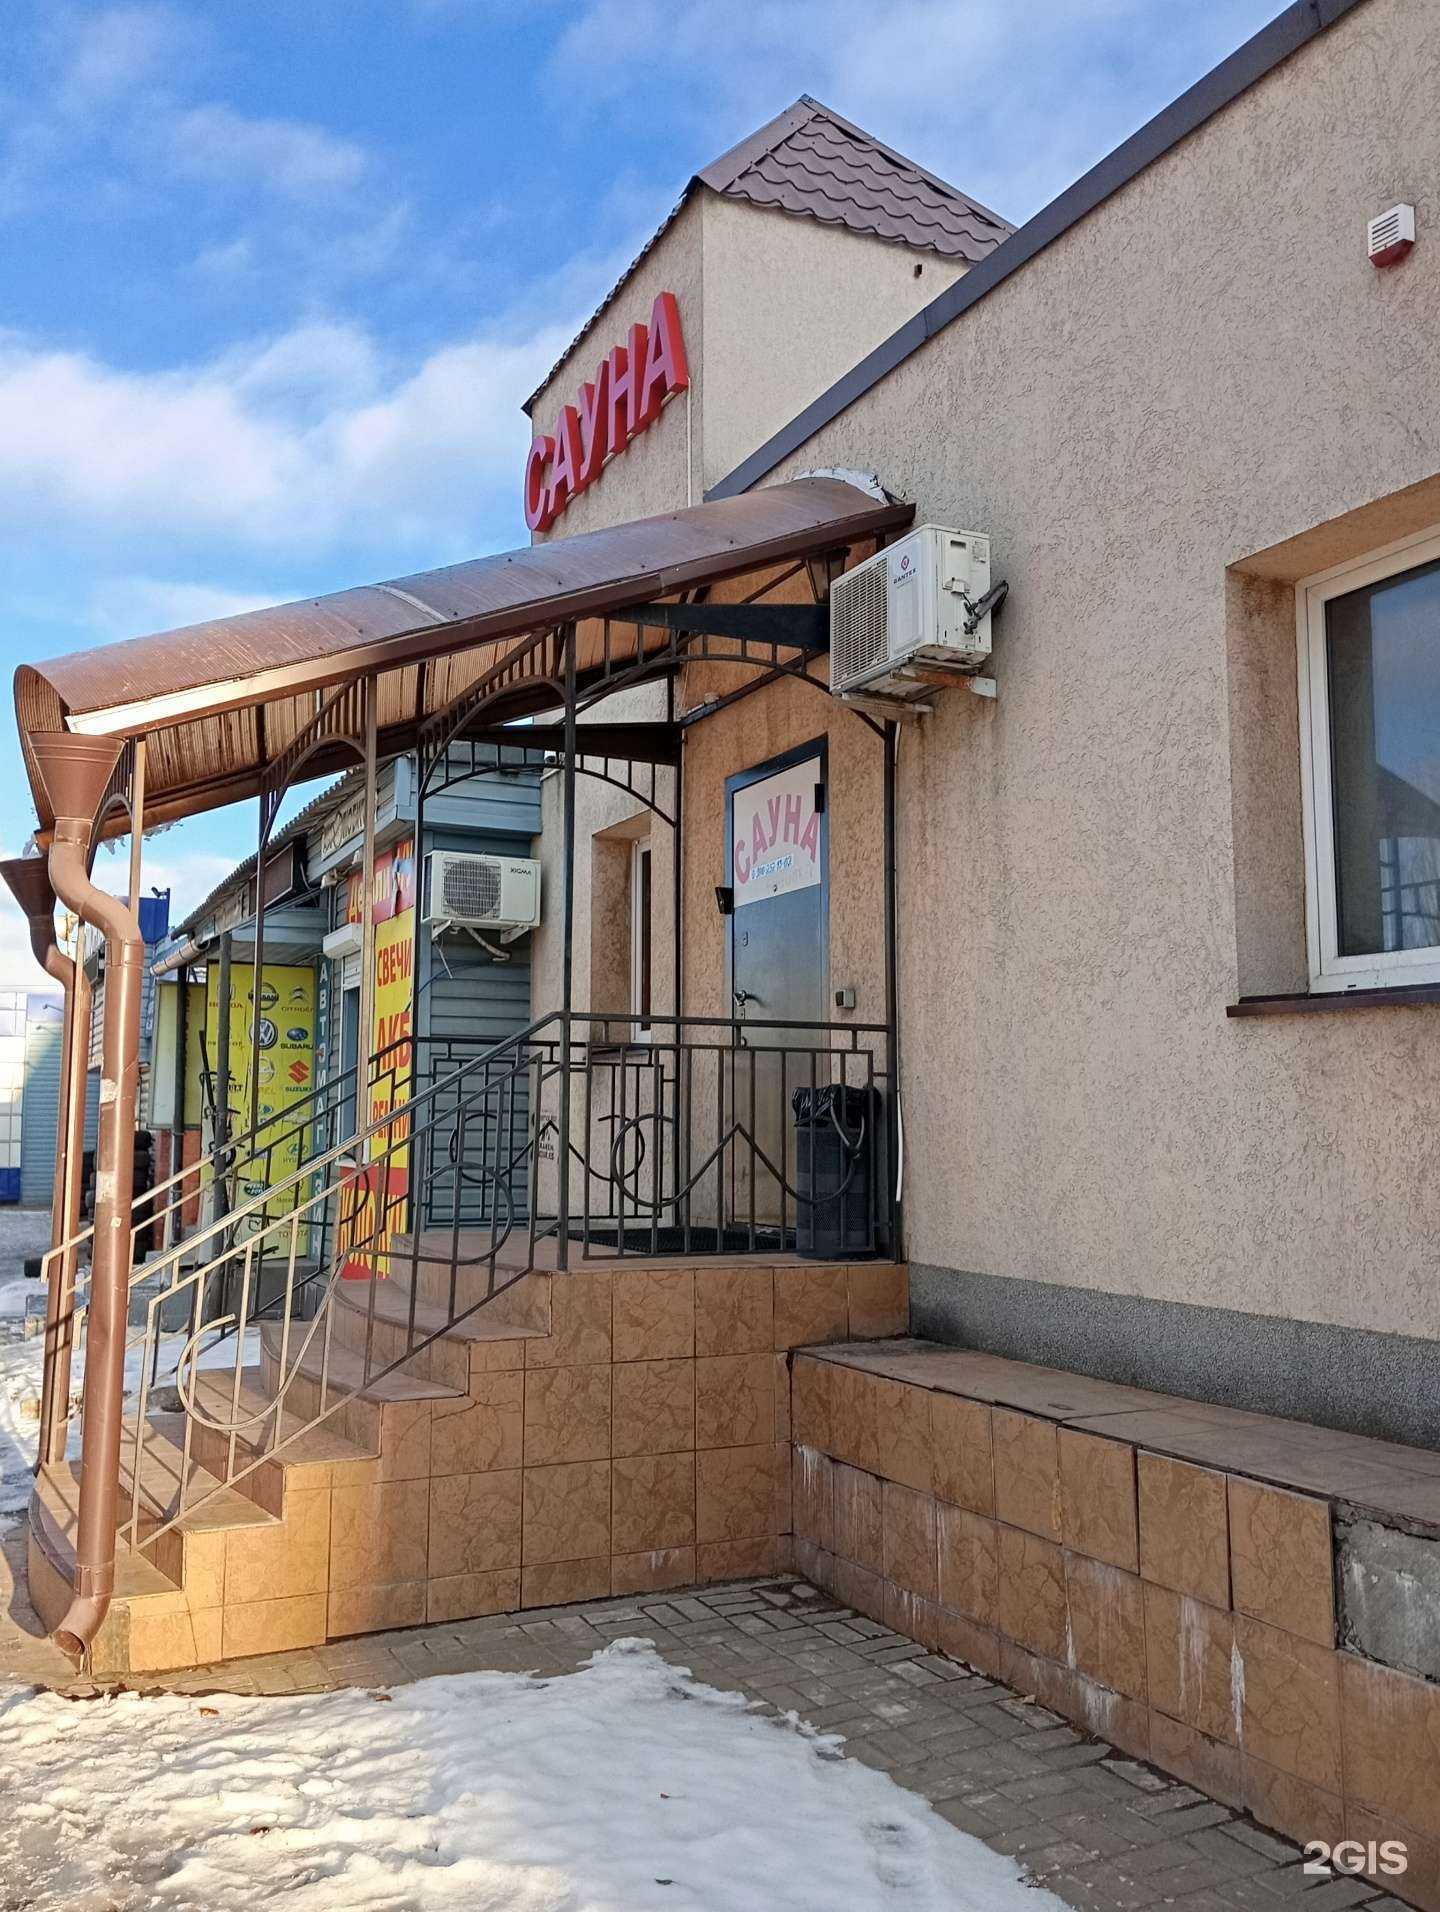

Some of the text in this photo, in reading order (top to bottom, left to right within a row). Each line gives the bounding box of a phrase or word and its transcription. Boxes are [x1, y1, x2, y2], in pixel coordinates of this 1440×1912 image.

[524, 291, 689, 532] САУНА
[734, 794, 819, 885] САУНА
[377, 937, 413, 988] СВЕЧИ
[377, 1010, 413, 1071] АКБ
